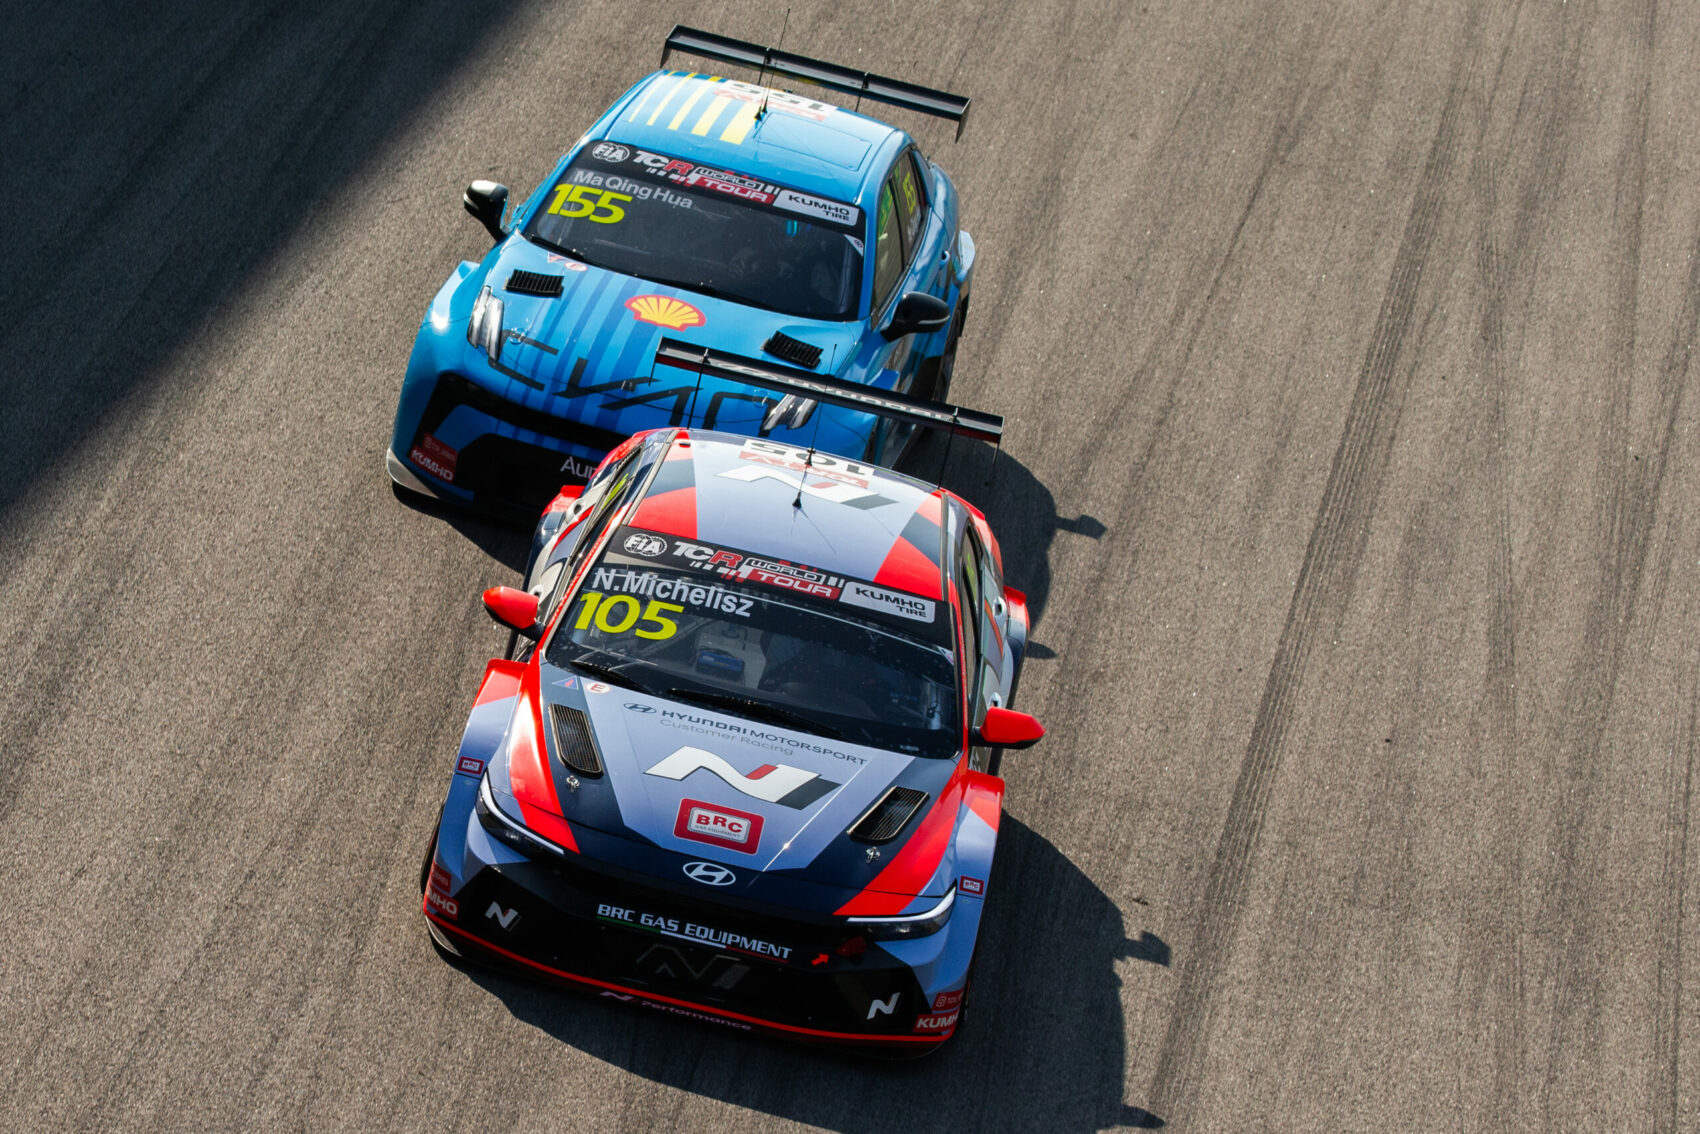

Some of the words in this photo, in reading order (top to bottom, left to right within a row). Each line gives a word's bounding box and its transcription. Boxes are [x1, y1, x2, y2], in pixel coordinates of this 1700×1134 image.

[595, 143, 627, 161] FIA
[633, 150, 694, 175] TCR
[698, 168, 761, 190] WORLD
[547, 184, 632, 224] 155
[704, 178, 768, 202] TOUR
[788, 194, 850, 216] KUMHO
[823, 210, 850, 221] TIRE
[411, 449, 454, 481] KUMHO
[625, 534, 663, 557] FIA
[672, 540, 743, 568] TCR
[751, 560, 818, 581] WORLD
[592, 568, 755, 618] N.Michelisz
[758, 571, 832, 597] TOUR
[855, 587, 926, 611] KUMHO
[574, 592, 684, 640] 105
[895, 605, 927, 618] TIRE
[660, 718, 737, 743] Customer
[740, 736, 794, 757] Racing
[661, 710, 747, 734] HYUNDAI
[751, 730, 868, 766] MOTORSPORT
[695, 814, 743, 833] BRC
[597, 903, 636, 922] BRC
[640, 913, 679, 932] GAS
[685, 923, 793, 959] EQUIPMENT
[642, 1000, 752, 1031] Performance
